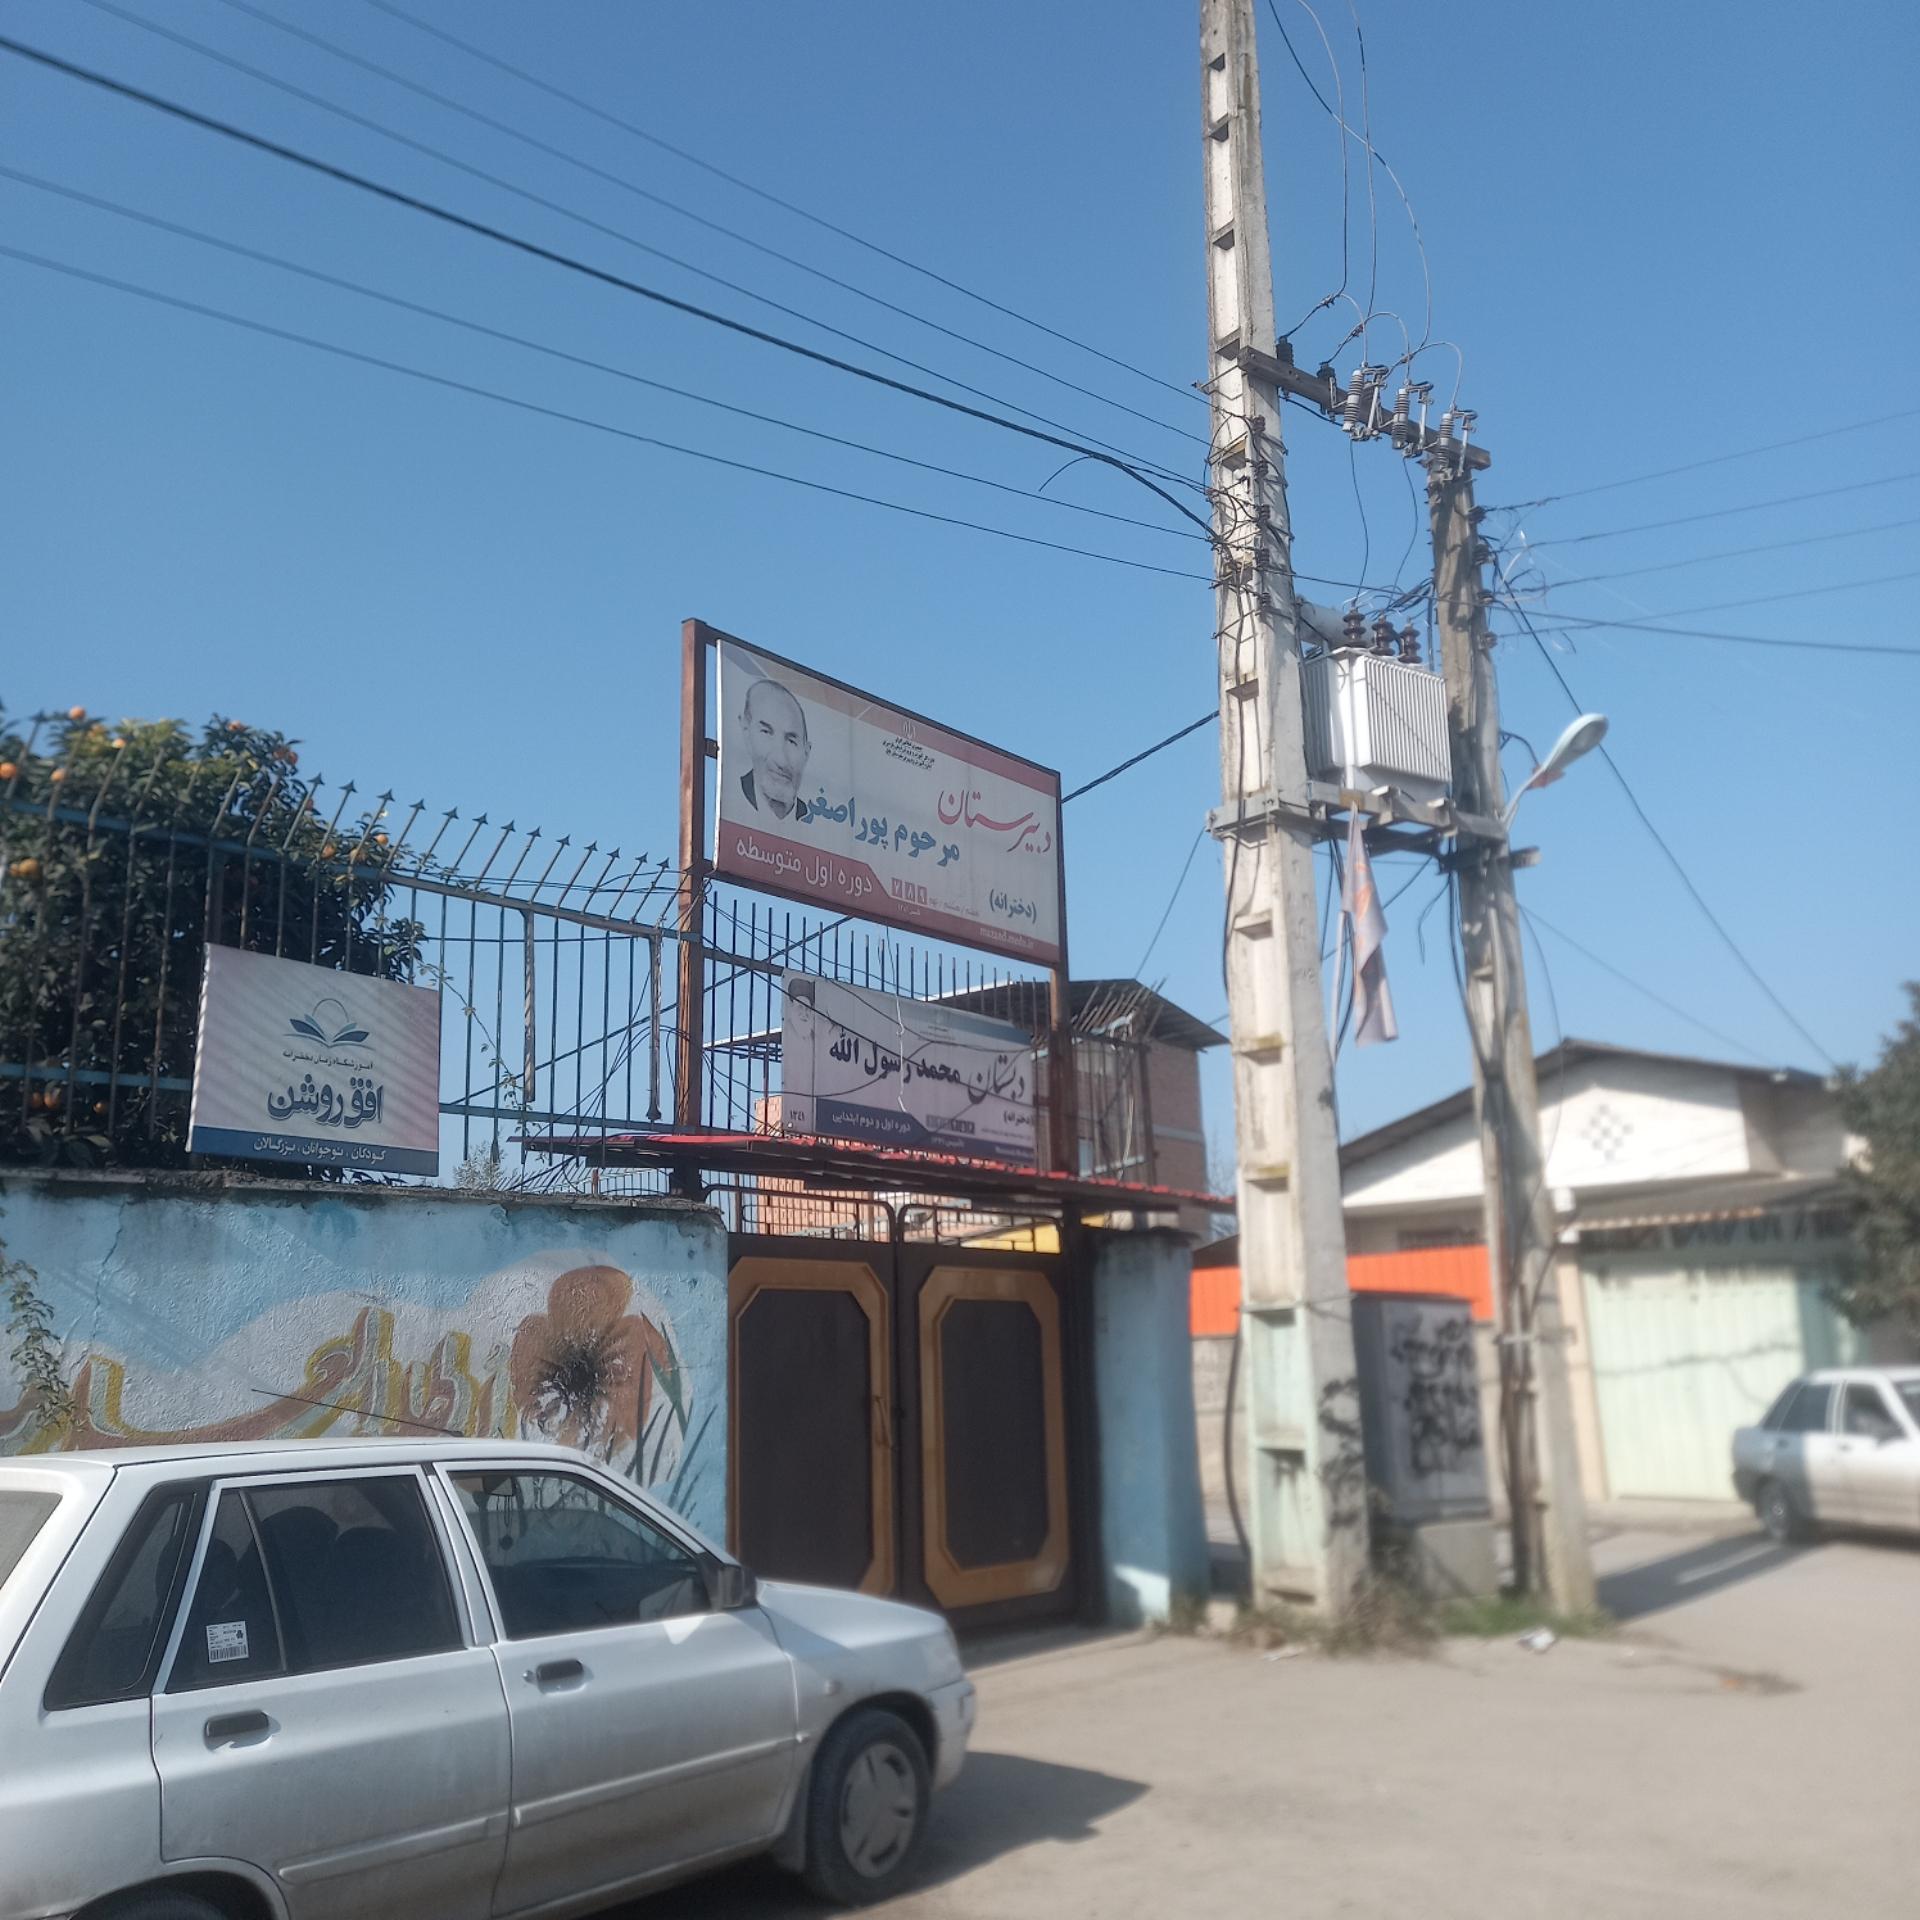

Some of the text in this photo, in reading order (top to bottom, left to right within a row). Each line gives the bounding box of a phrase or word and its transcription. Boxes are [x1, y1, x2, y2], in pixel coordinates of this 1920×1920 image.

[894, 824, 960, 868] مرحوم
[938, 789, 1052, 853] دبیرستان
[736, 836, 873, 897] دوره اول متوسطه
[989, 888, 1037, 924] (دخترانه)
[828, 1032, 1026, 1105] دبستان محمد رسول الله
[267, 1073, 384, 1129] افق روشن
[302, 1140, 344, 1160] نوجوانان
[351, 1146, 387, 1165] کودکان
